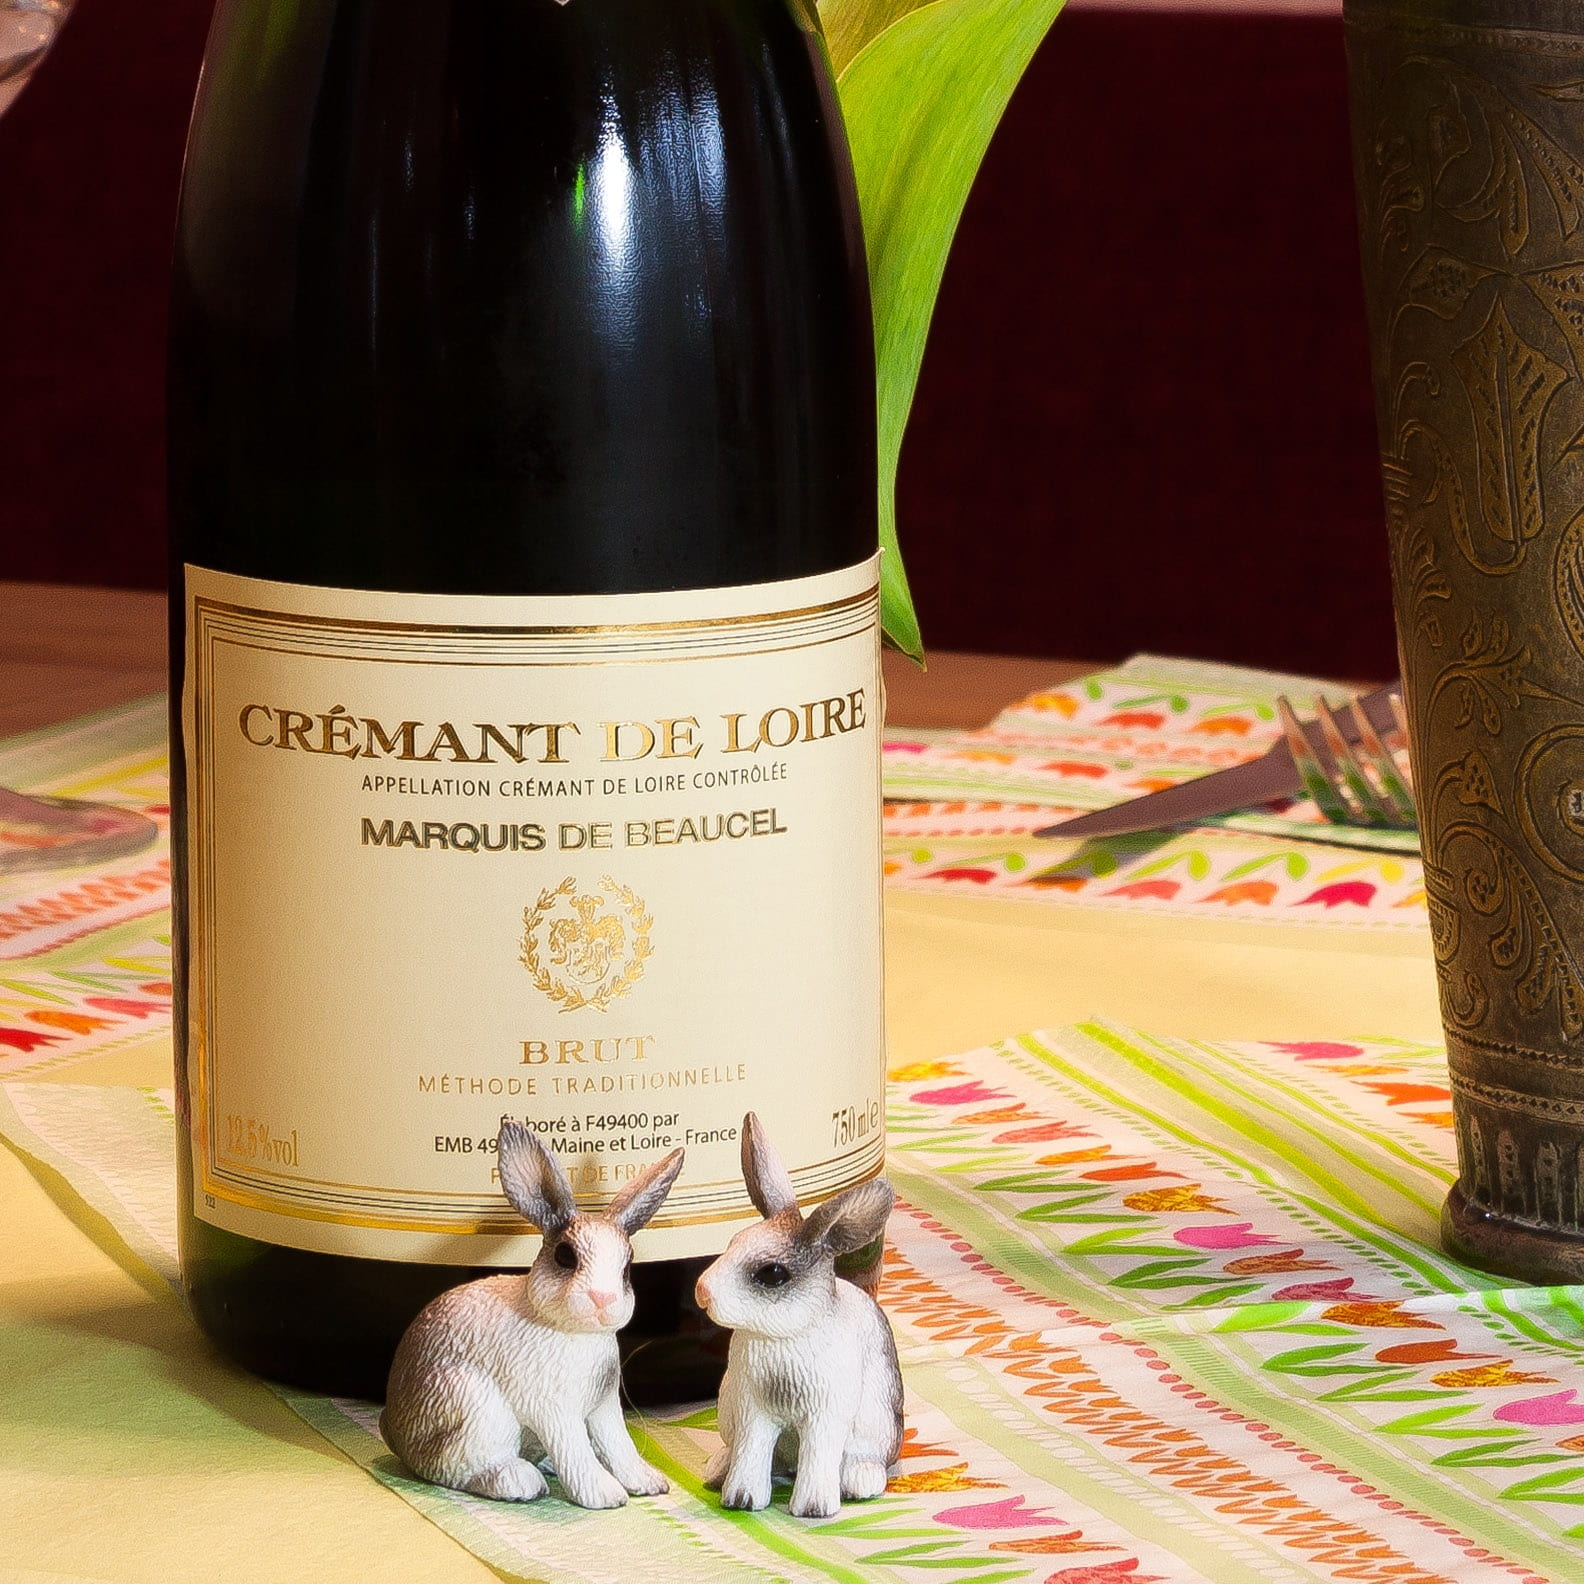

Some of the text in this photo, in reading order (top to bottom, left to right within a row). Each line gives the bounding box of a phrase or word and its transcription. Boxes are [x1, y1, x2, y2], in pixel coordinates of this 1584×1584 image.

[239, 687, 868, 764] CRÉMANT DE LOIRE
[362, 762, 788, 797] APPELLATION CRÉMANT DE LOIRE CONTRÔLÉE
[360, 807, 788, 854] MARQUIS DE BEAUCEL
[518, 1034, 657, 1066] BRUT
[418, 1063, 748, 1097] MÉTHODE TRADITIONNELLE
[499, 1111, 680, 1134] Éboré à F49400 par
[434, 1136, 474, 1154] EMB
[551, 1137, 606, 1155] Maine
[609, 1137, 627, 1153] et
[630, 1132, 672, 1151] Loire
[685, 1126, 738, 1146] France
[583, 1165, 609, 1183] DE
